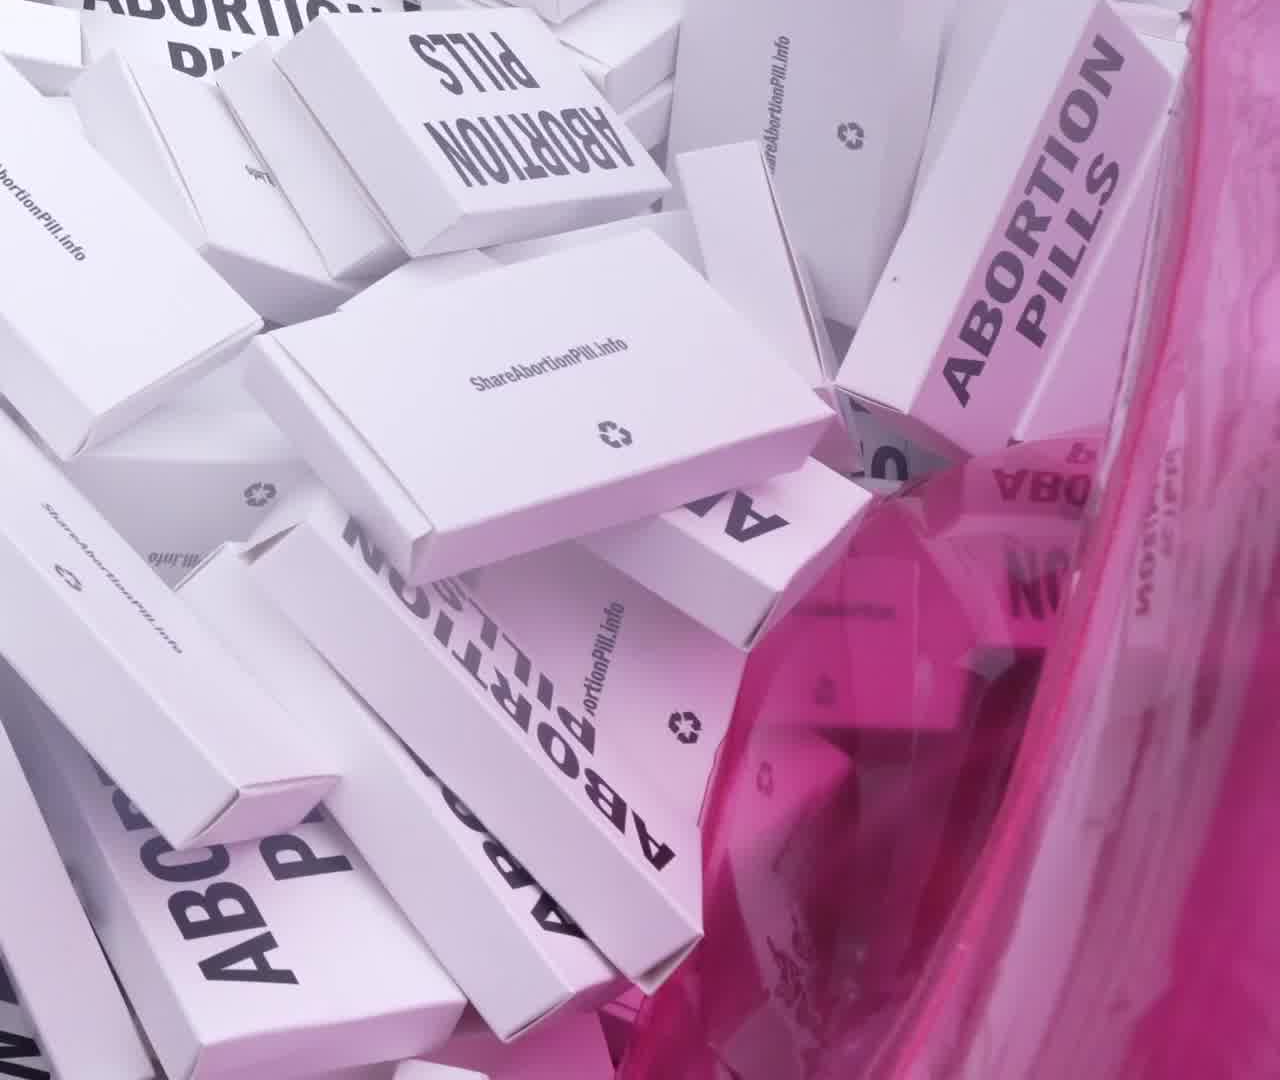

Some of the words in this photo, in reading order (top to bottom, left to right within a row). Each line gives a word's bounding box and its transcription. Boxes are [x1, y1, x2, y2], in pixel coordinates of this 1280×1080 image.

[408, 32, 541, 96] PILLS
[424, 106, 636, 188] ABORTION
[940, 32, 1127, 409] ABORTION
[1014, 151, 1121, 350] PILLS
[469, 336, 630, 393] ShareAbortionPill.info
[40, 501, 185, 655] ShareAbortionPill.info
